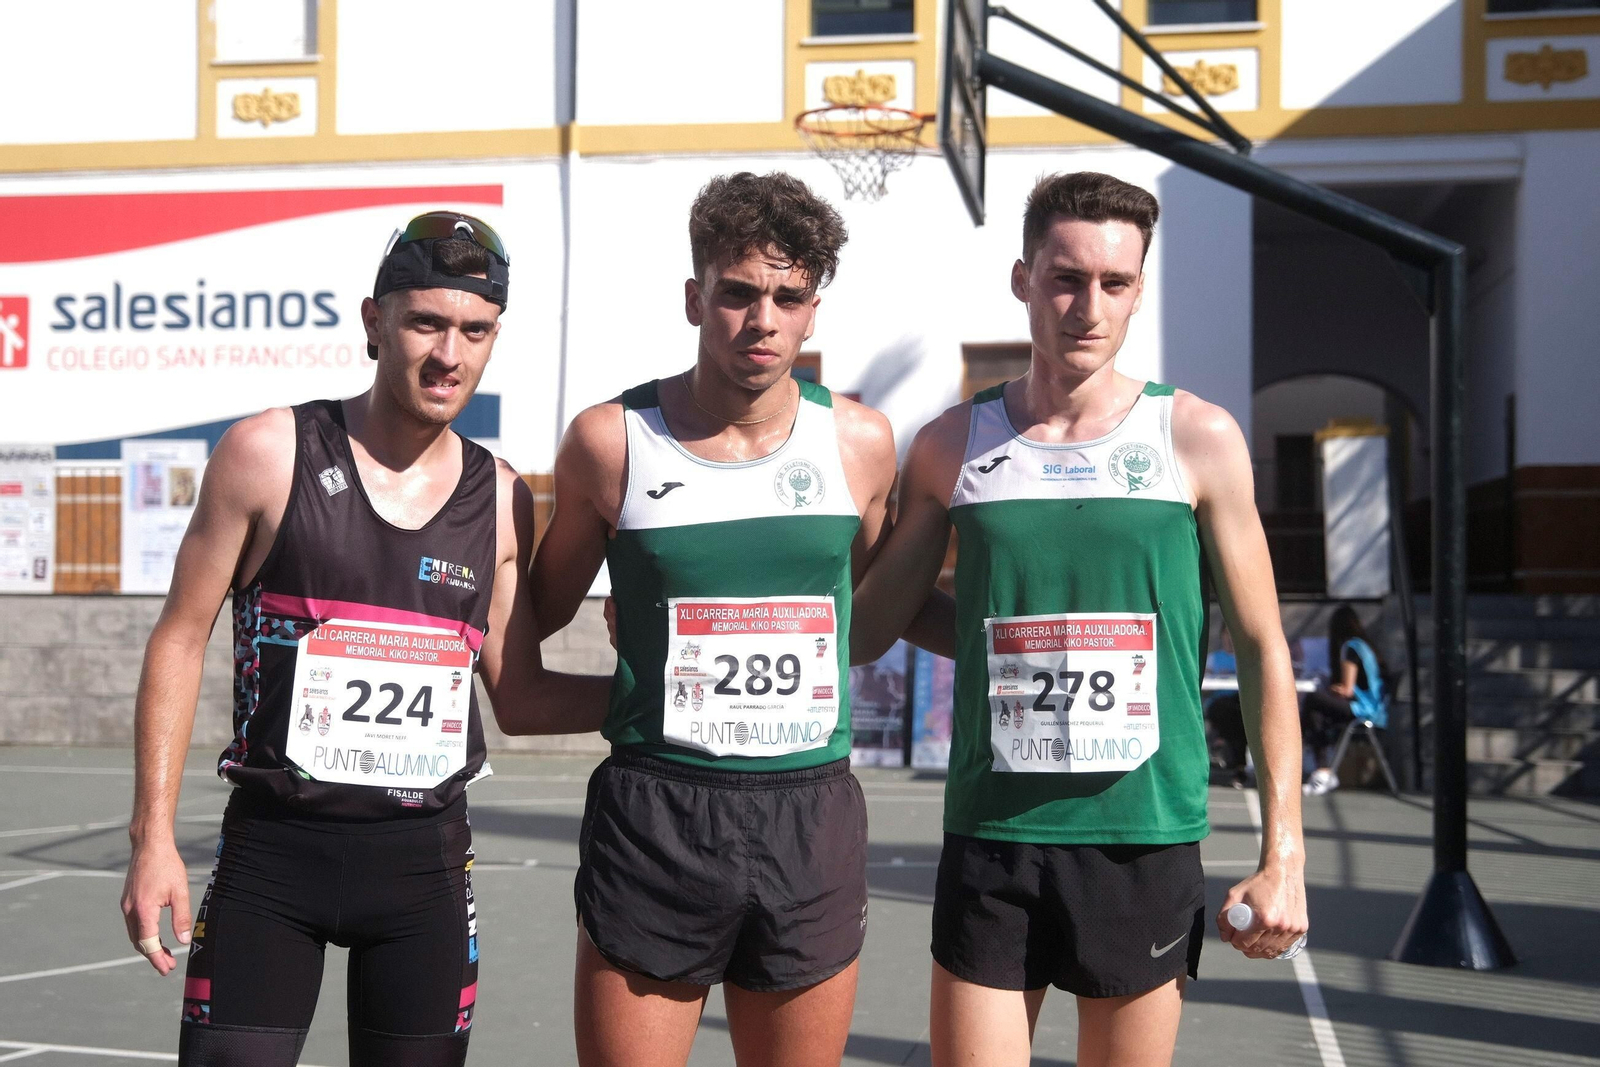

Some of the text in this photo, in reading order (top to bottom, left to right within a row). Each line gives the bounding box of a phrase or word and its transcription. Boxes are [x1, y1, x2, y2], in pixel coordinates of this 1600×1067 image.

[50, 279, 341, 333] salesianos
[46, 345, 150, 371] COLEGIO
[156, 345, 206, 369] SAN
[213, 343, 353, 368] FRANCISCO
[1042, 464, 1096, 475] SIG Laboral
[418, 556, 476, 581] ENTRENA
[680, 609, 695, 620] XLI
[696, 608, 740, 620] CARRERA
[771, 607, 830, 619] AUXILIADORA.
[711, 621, 749, 632] MEMORIAL
[751, 620, 770, 630] KIKO
[995, 628, 1008, 640] XLI
[1009, 626, 1051, 638] CARRERA
[1084, 624, 1148, 636] AUXILIADORA.
[311, 627, 327, 640] XLI
[329, 630, 376, 645] CARRERA
[1024, 639, 1063, 650] MEMORIAL
[1063, 638, 1082, 647] KIKO
[345, 645, 387, 658] MEMORIAL
[389, 649, 408, 660] KIKO
[713, 653, 801, 696] 289
[1032, 670, 1115, 712] 278
[342, 679, 434, 727] 224
[387, 788, 424, 800] FISALDE
